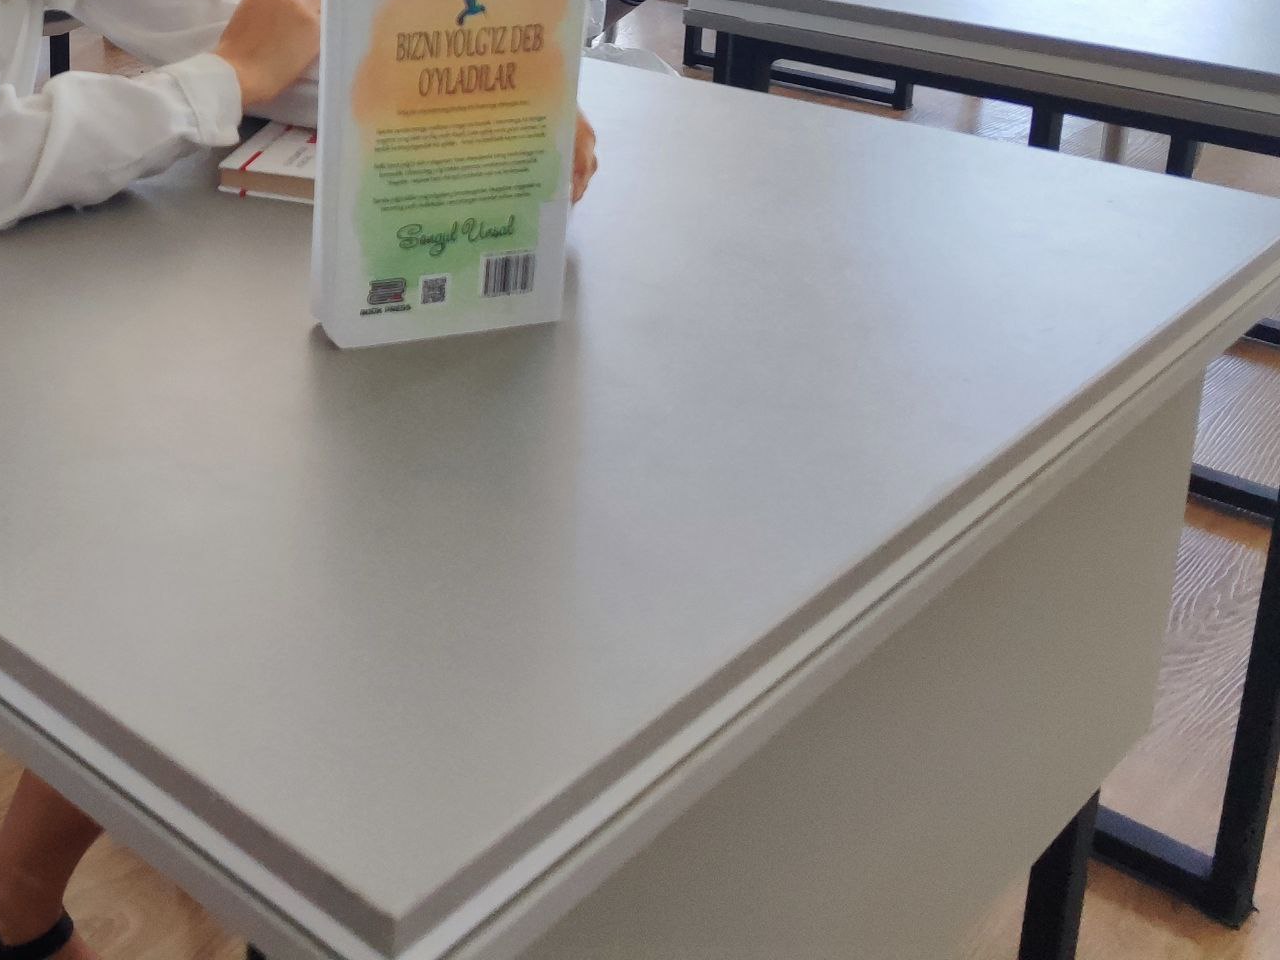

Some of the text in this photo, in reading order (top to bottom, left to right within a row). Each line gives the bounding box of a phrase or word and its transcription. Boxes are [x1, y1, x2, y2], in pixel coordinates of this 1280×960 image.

[396, 31, 440, 61] BIZNI
[511, 24, 544, 53] DEB
[418, 62, 517, 96] O'YLADILAR
